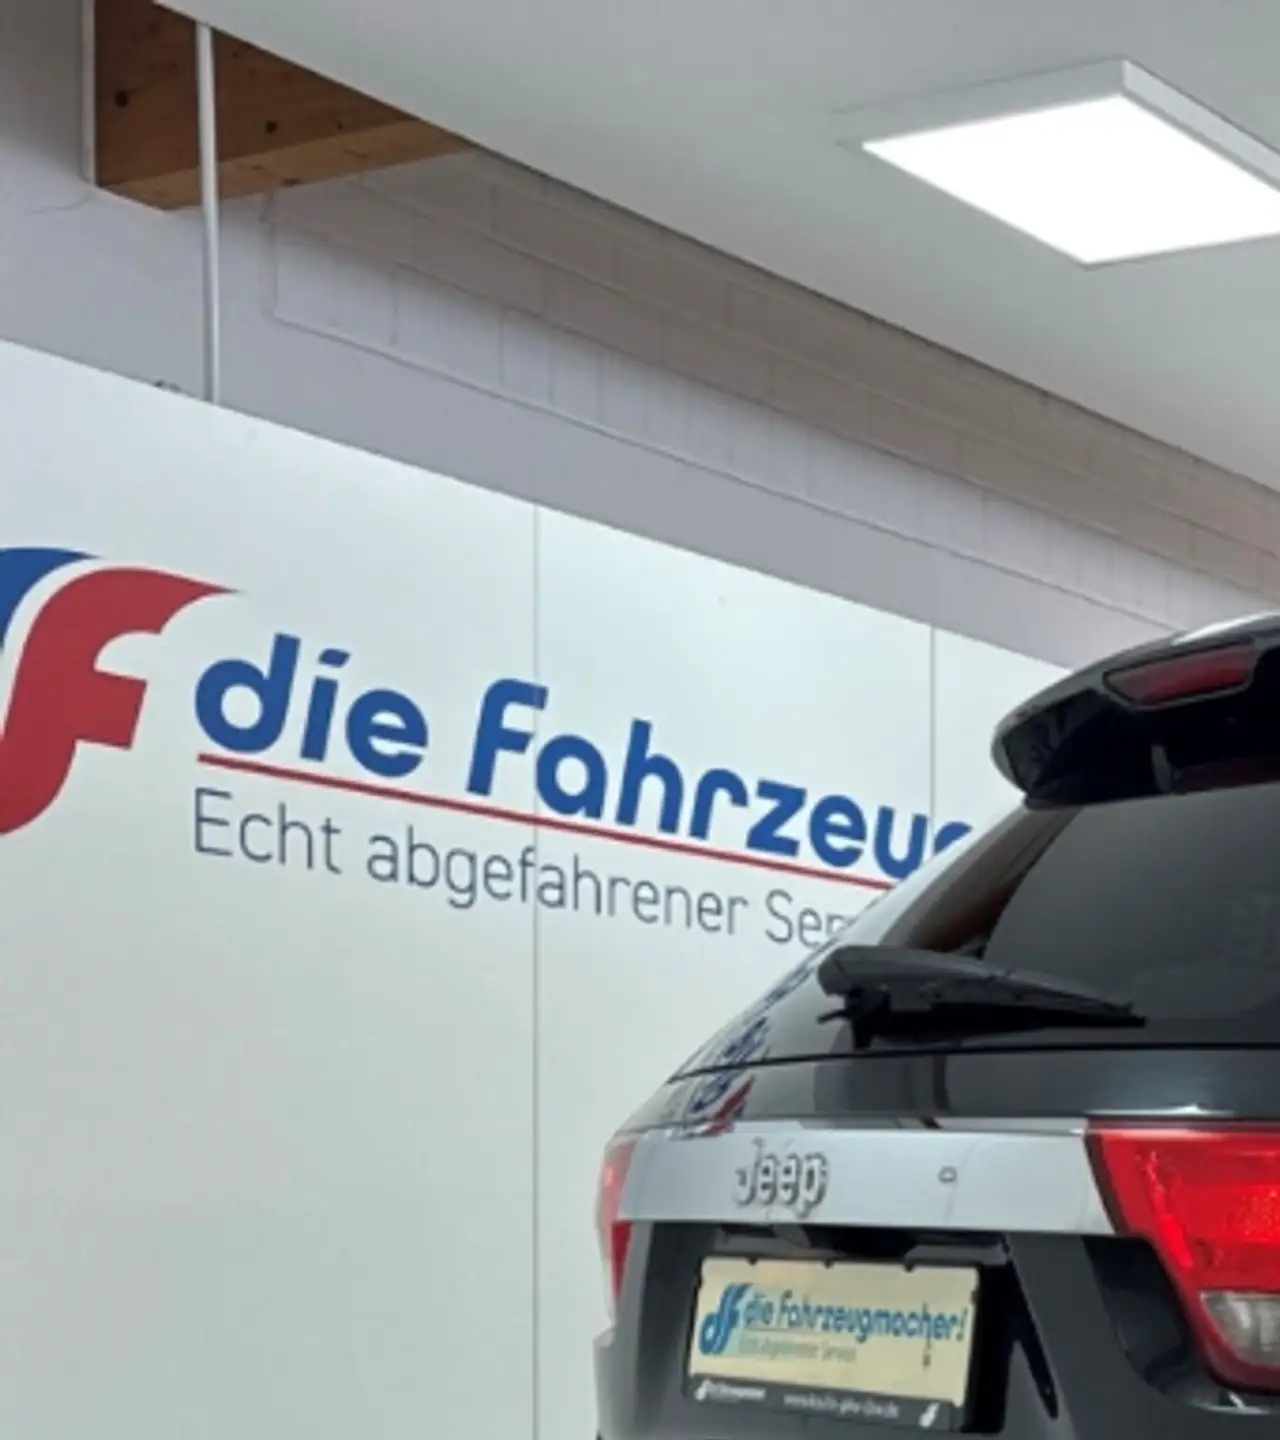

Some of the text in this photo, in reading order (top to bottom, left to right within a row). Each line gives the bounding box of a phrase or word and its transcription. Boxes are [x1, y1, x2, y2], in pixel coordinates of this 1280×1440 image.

[194, 633, 429, 777] die
[194, 787, 342, 875] Echt
[366, 824, 747, 936] abgefahrener
[733, 1137, 829, 1219] Jeep
[743, 1289, 968, 1343] die Fahrzeugmacher!
